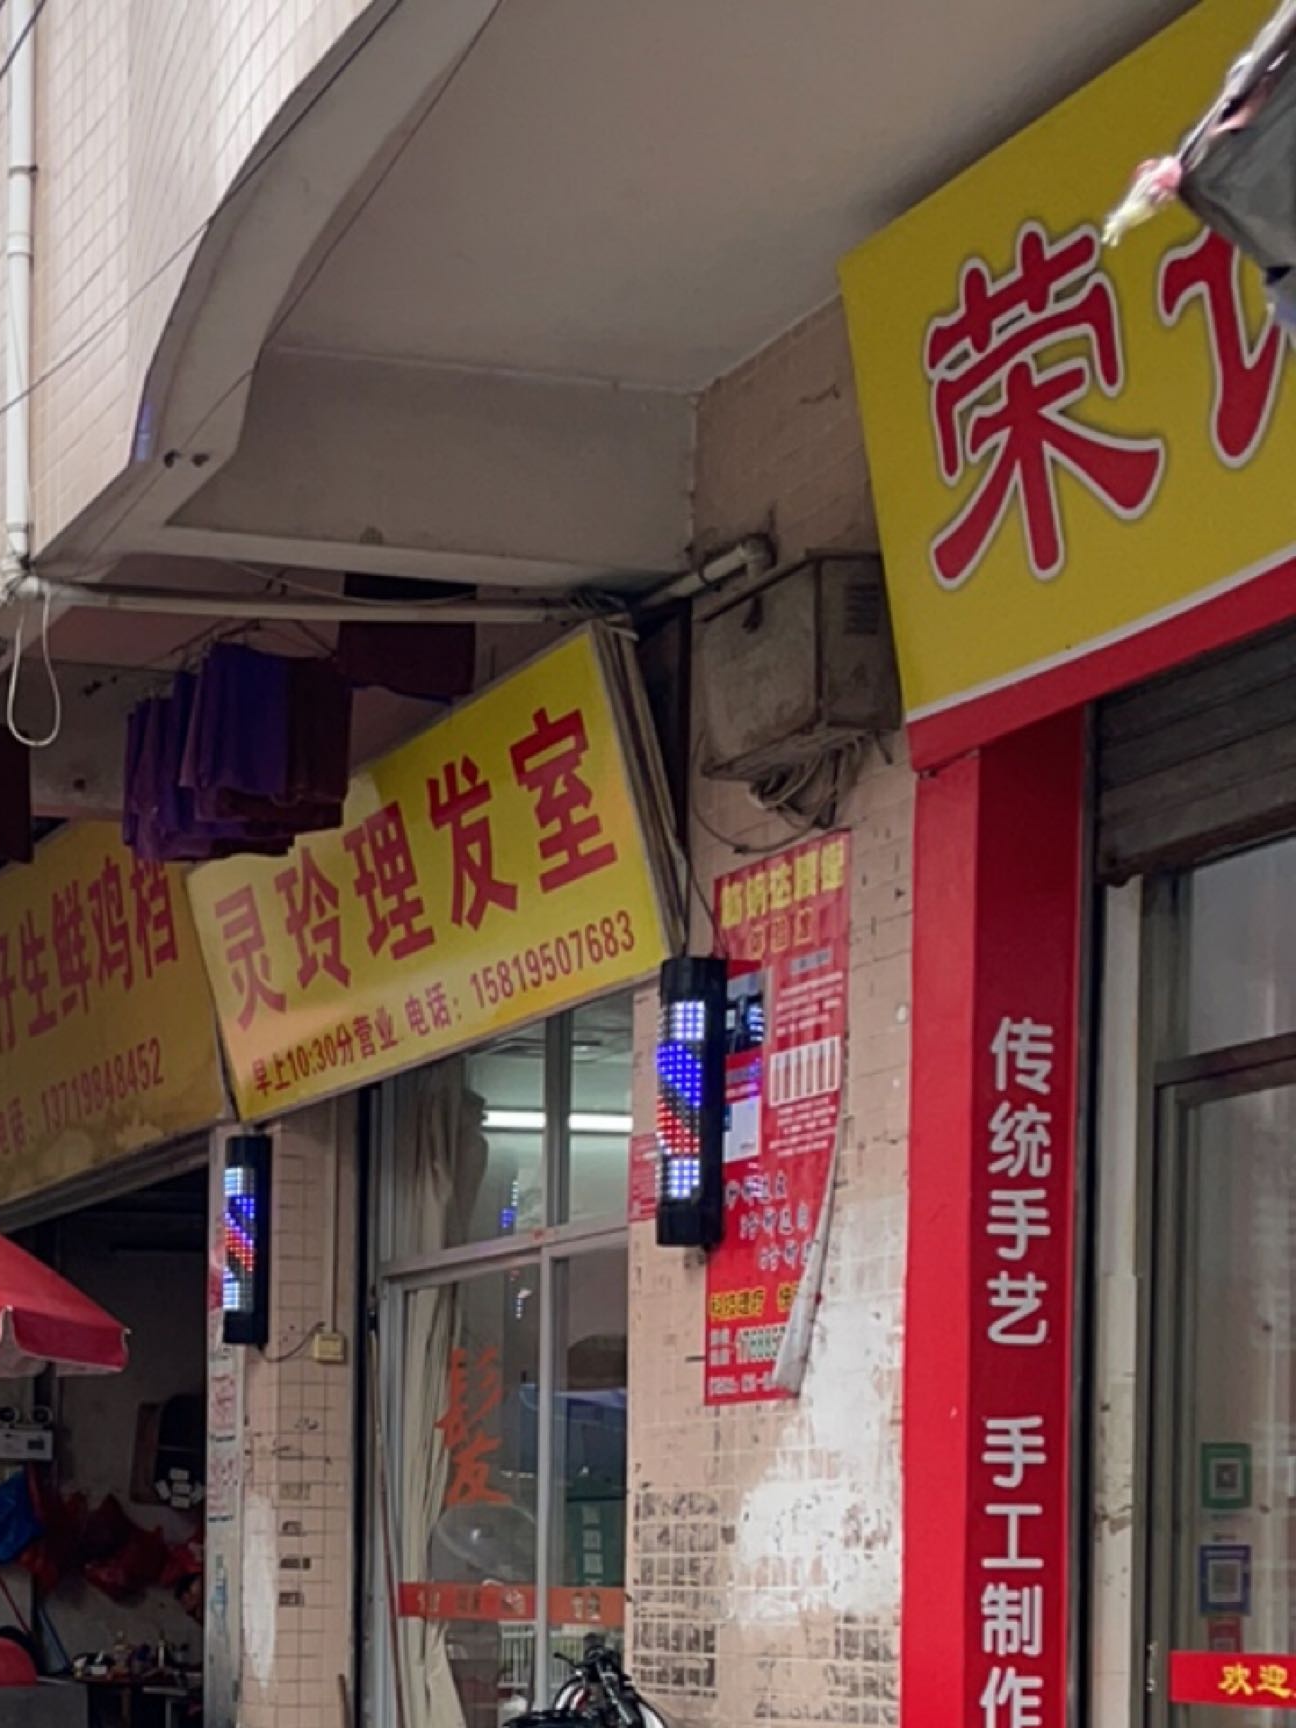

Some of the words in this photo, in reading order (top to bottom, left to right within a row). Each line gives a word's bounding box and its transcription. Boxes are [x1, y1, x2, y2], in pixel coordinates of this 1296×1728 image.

[214, 706, 619, 1031] 灵玲理发室
[985, 1016, 1054, 1346] 传统手艺
[1217, 1662, 1296, 1698] 欢迎
